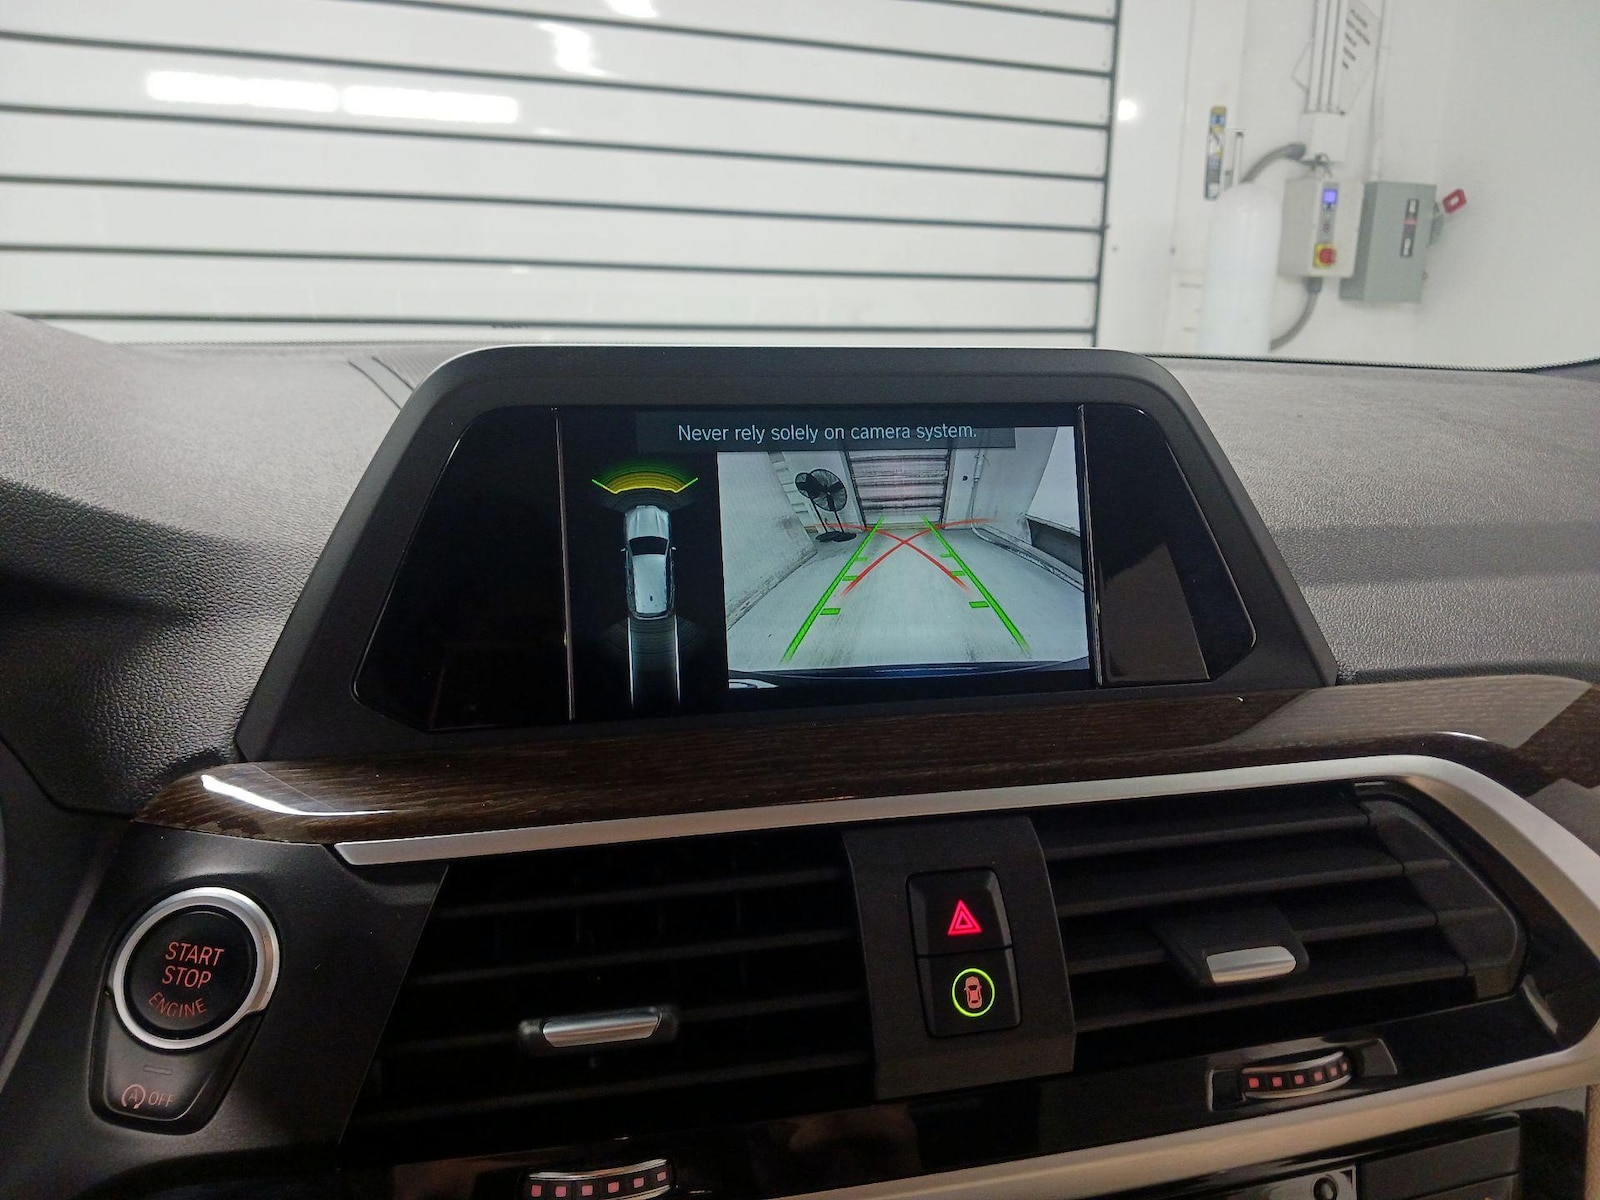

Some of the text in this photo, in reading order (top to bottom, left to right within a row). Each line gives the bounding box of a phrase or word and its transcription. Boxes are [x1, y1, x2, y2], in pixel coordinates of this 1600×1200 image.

[678, 423, 977, 444] Never rely solely on camera system.
[165, 941, 224, 966] START
[162, 966, 211, 989] STOP
[149, 992, 207, 1017] ENGINE
[149, 1092, 174, 1107] OFF
